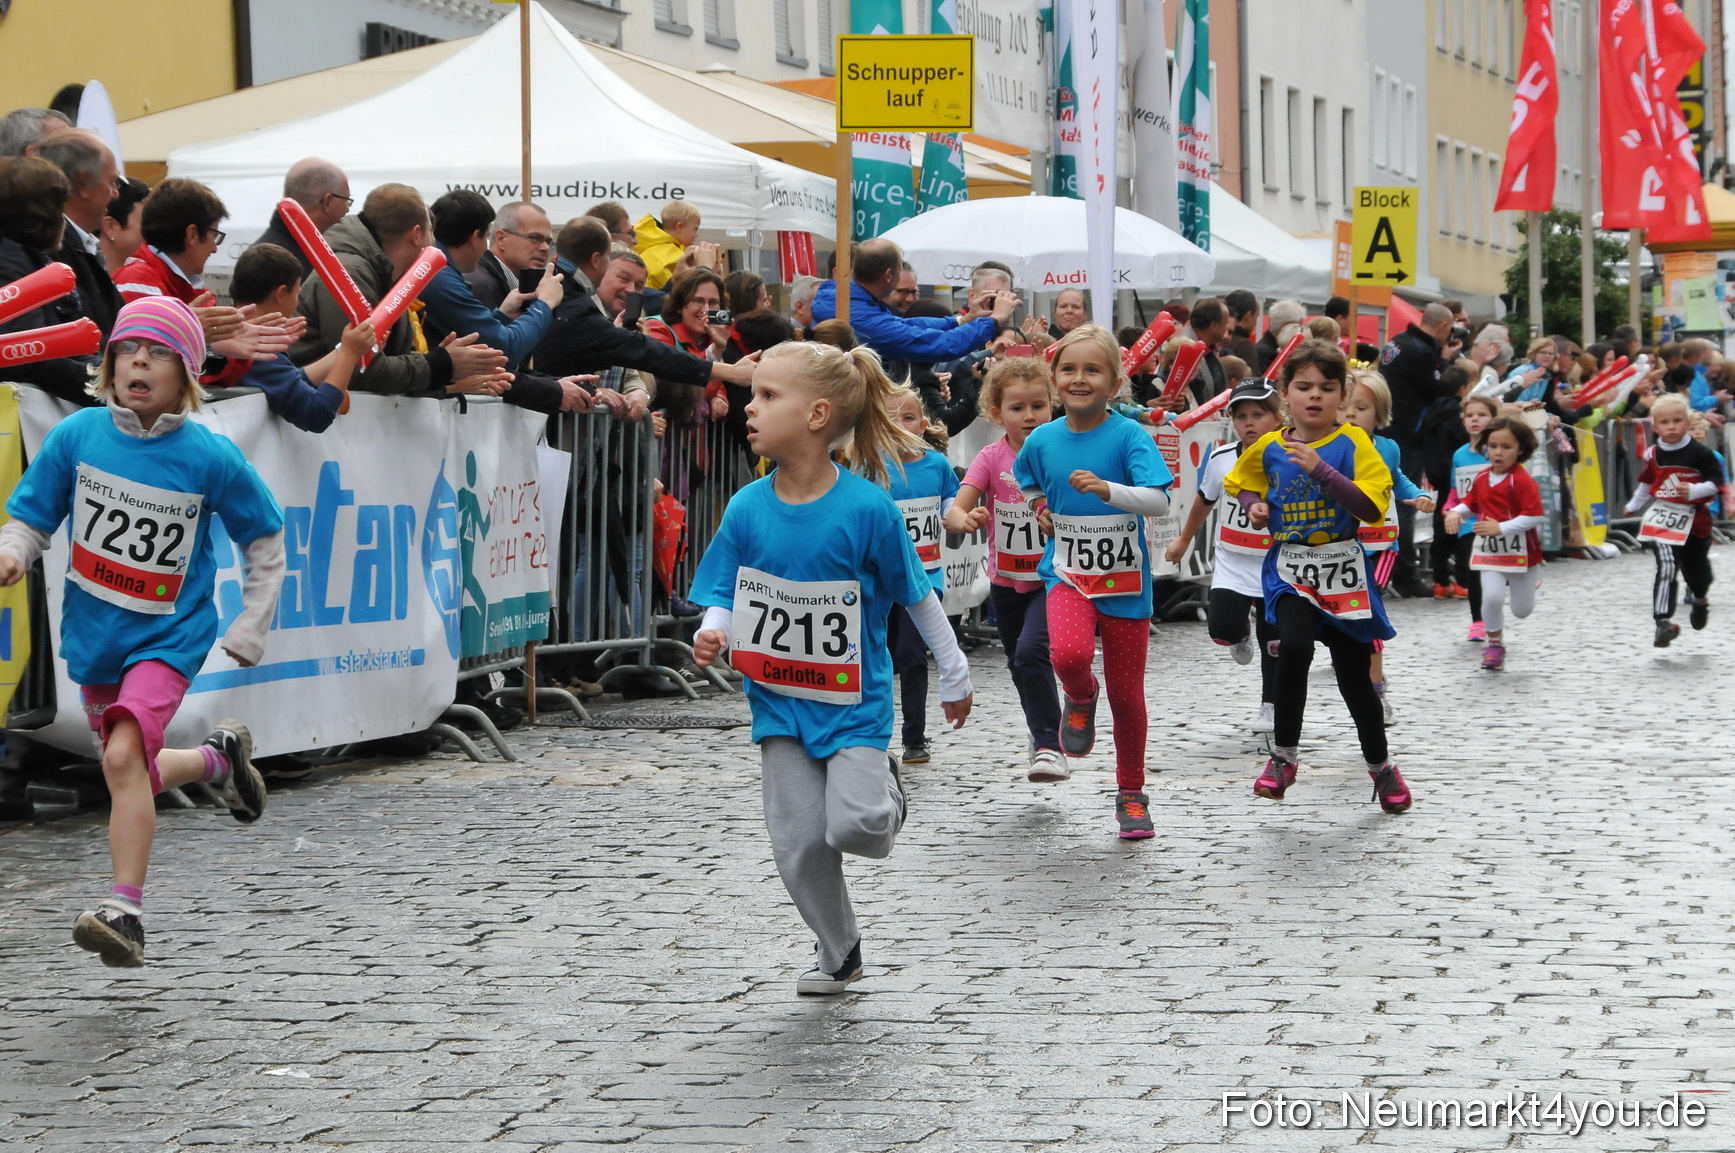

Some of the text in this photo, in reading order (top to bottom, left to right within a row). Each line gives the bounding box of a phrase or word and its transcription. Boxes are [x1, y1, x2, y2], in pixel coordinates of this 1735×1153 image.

[847, 62, 965, 85] Schnupper-
[886, 88, 925, 107] lauf
[446, 181, 686, 201] www.audibkk.de
[1360, 190, 1410, 208] Block
[1364, 216, 1402, 264] A
[1043, 269, 1088, 286] Audi
[384, 280, 416, 314] Audi BKK
[79, 475, 182, 517] PARTL Neumarkt
[995, 507, 1020, 519] PARTL
[83, 497, 185, 568] 7232
[1054, 521, 1125, 534] PARTL Neumarkt
[1060, 536, 1136, 571] 7584
[93, 561, 146, 594] Hanna
[739, 579, 837, 606] PARTL Neumarkt
[748, 599, 849, 658] 7213
[762, 660, 826, 686] Carlotta
